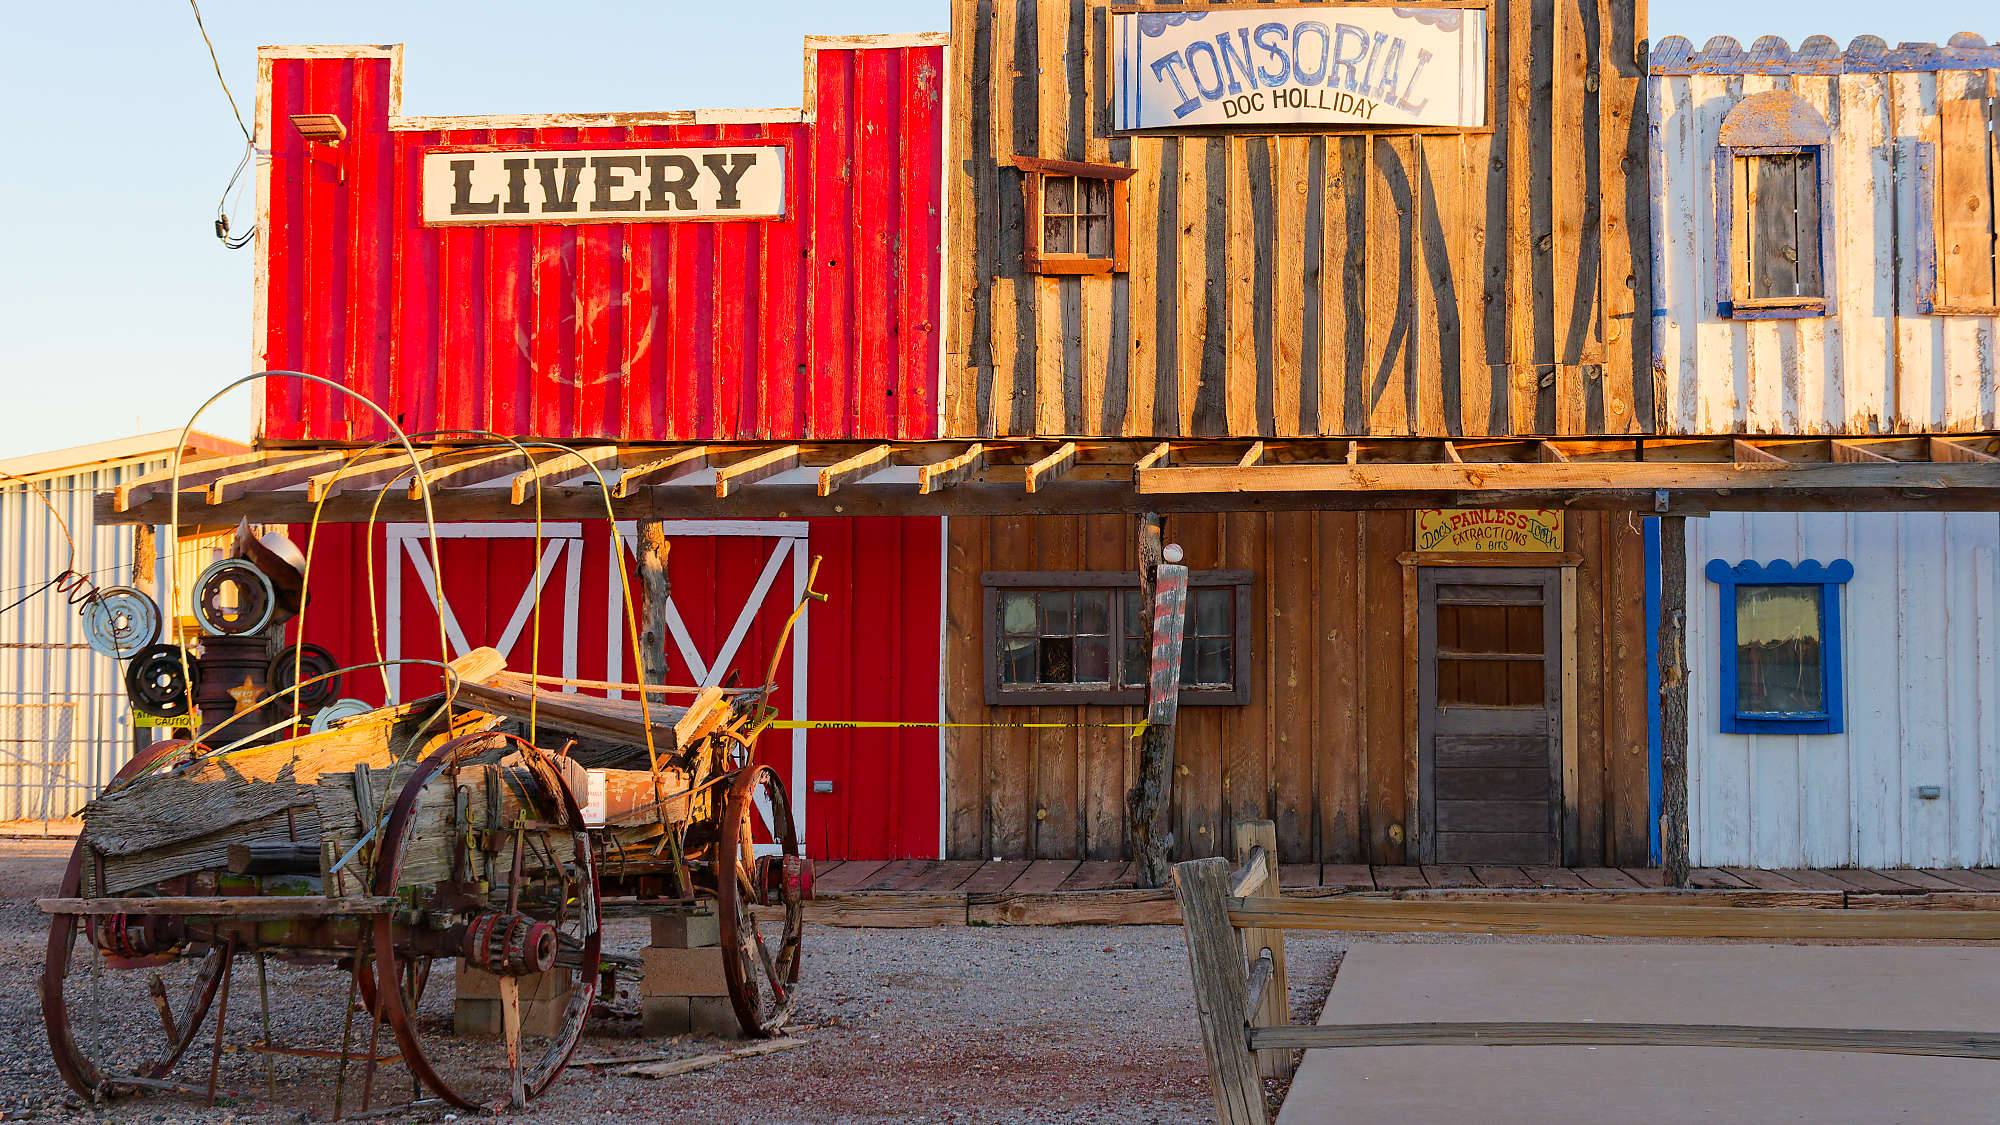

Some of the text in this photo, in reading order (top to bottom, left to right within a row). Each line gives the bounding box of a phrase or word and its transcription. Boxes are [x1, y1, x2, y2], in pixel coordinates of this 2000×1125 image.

[1150, 20, 1434, 120] TONSORIAL
[1222, 87, 1378, 120] DOC HOLLIDAY
[449, 153, 757, 216] LIVERY
[1420, 508, 1561, 550] Doc's PAINLESS Tooth
[1452, 526, 1528, 546] EXTRACTIONS
[1475, 540, 1509, 551] 6 BITS
